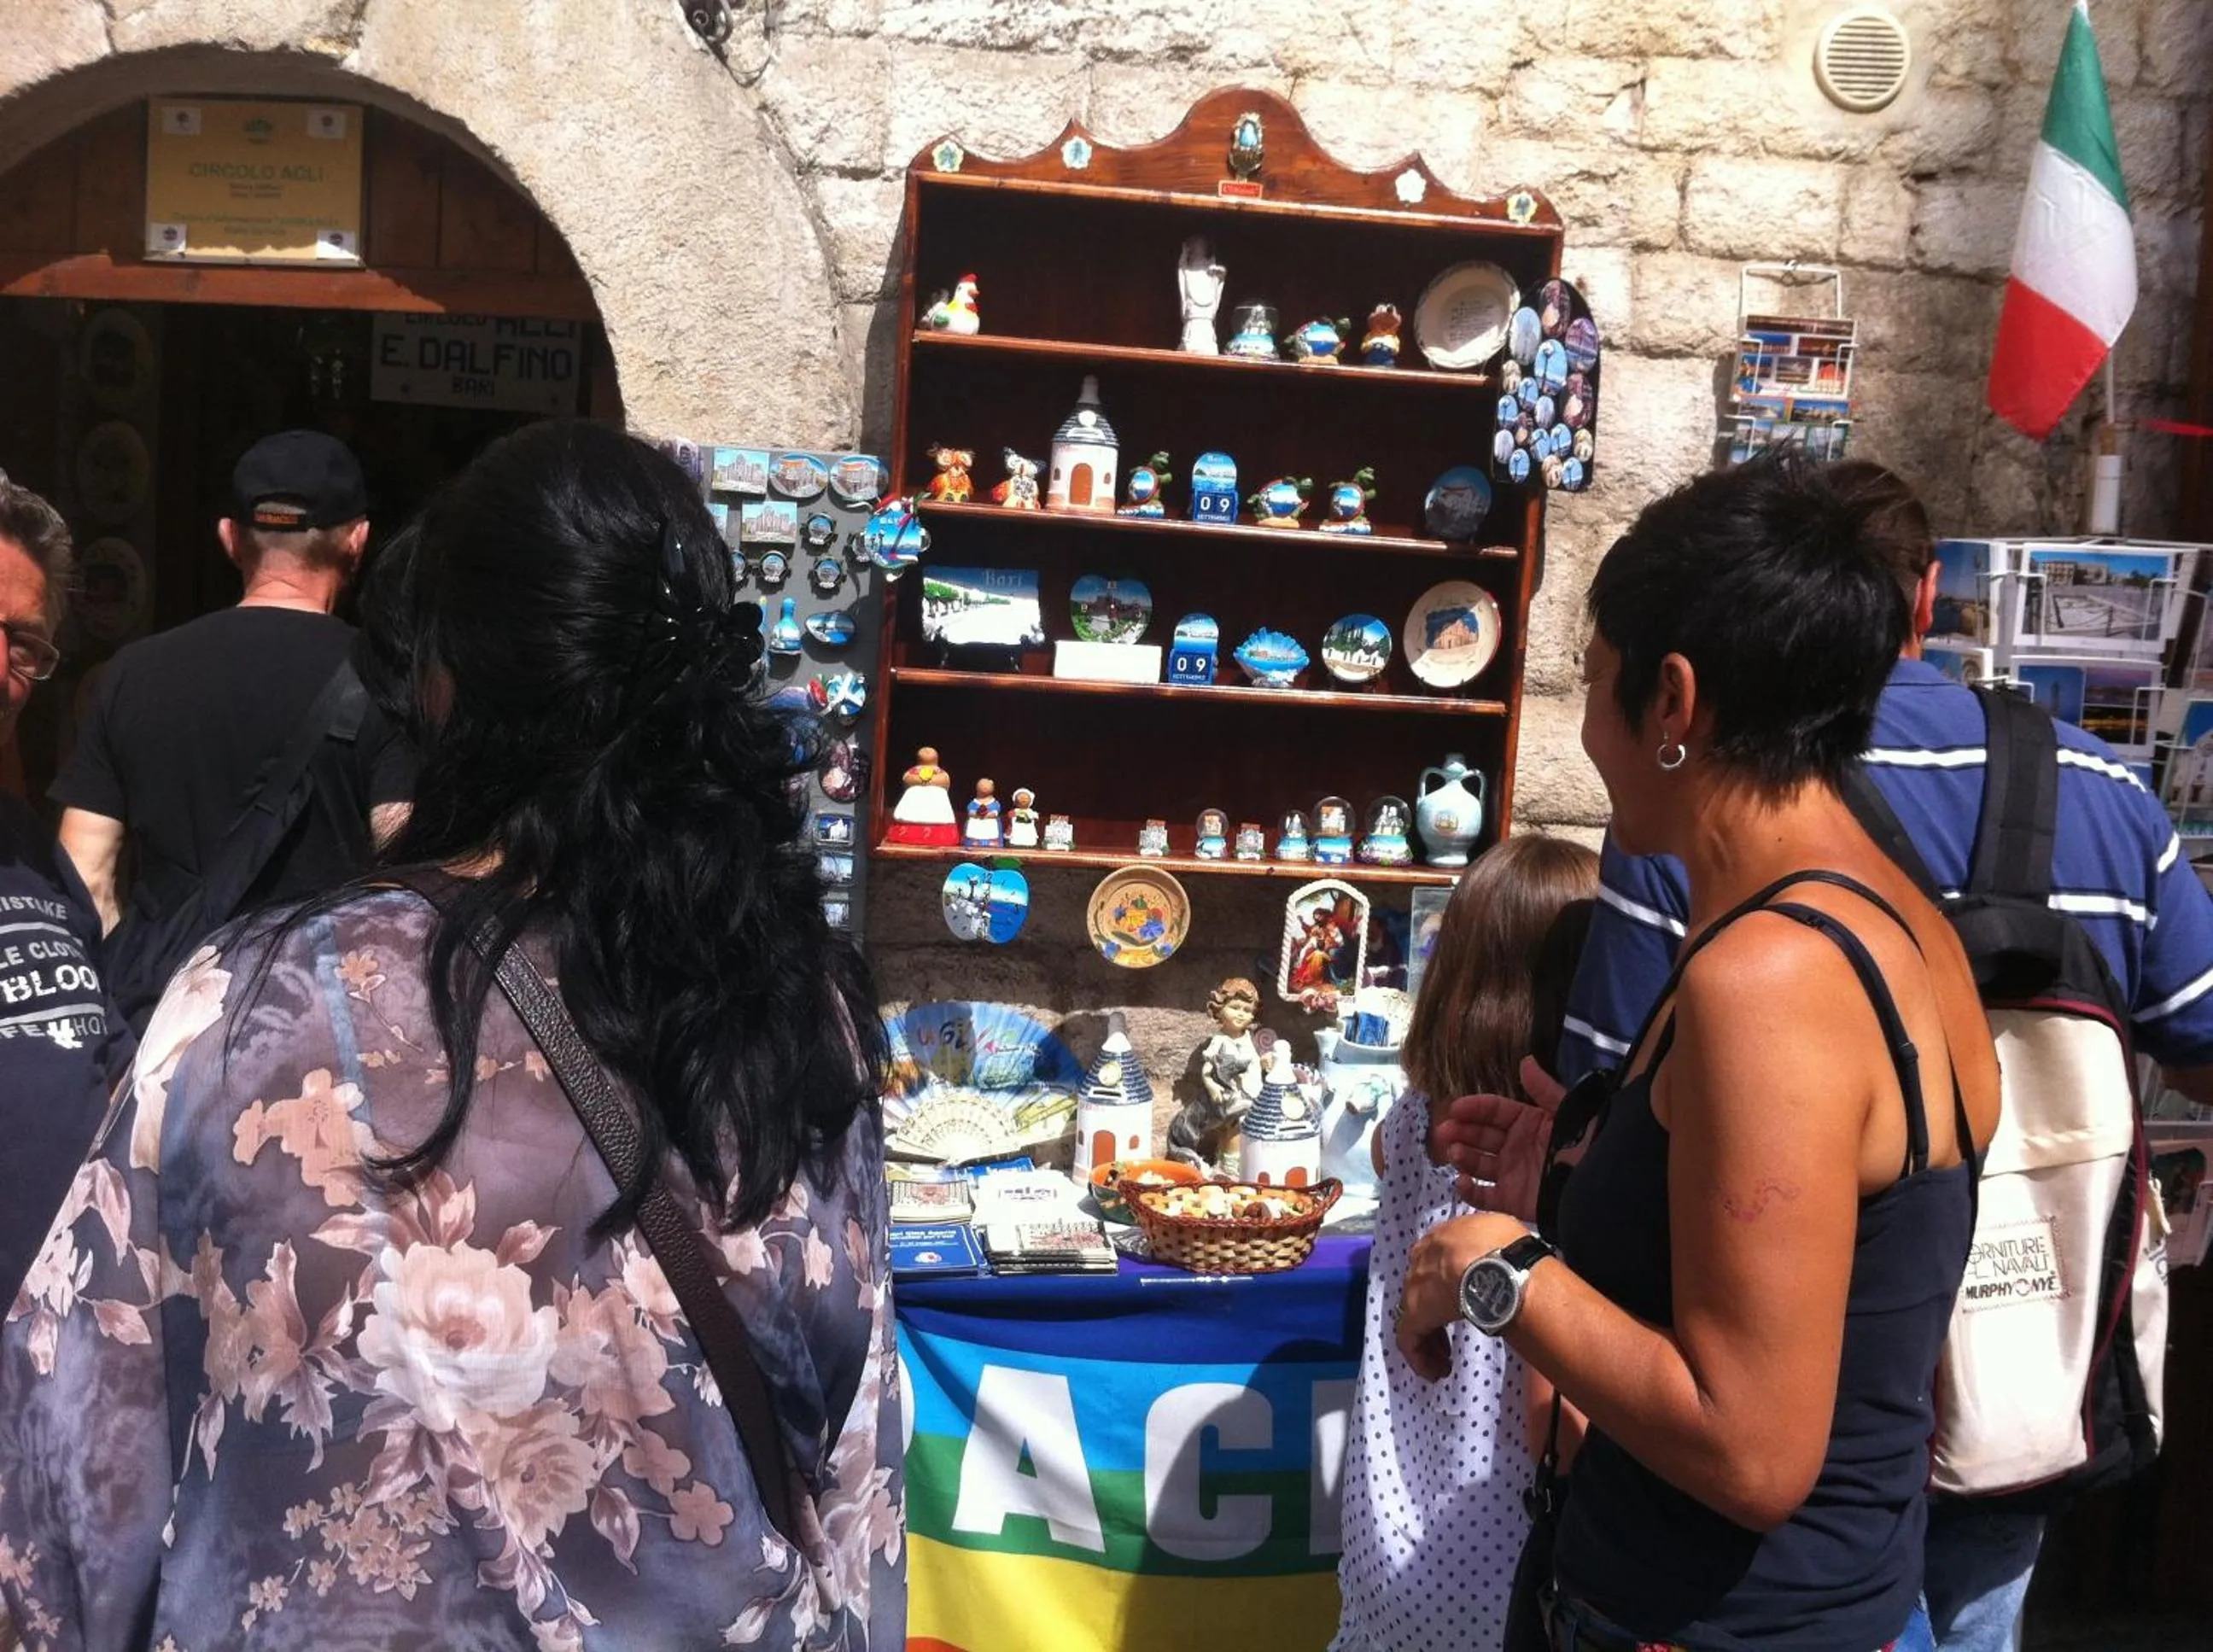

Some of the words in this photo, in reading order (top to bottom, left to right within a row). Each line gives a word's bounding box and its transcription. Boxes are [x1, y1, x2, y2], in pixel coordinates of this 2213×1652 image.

[419, 336, 572, 381] DALFINO
[452, 375, 495, 396] BARI
[0, 966, 102, 1003] BLOO
[898, 1356, 1358, 1561] AC
